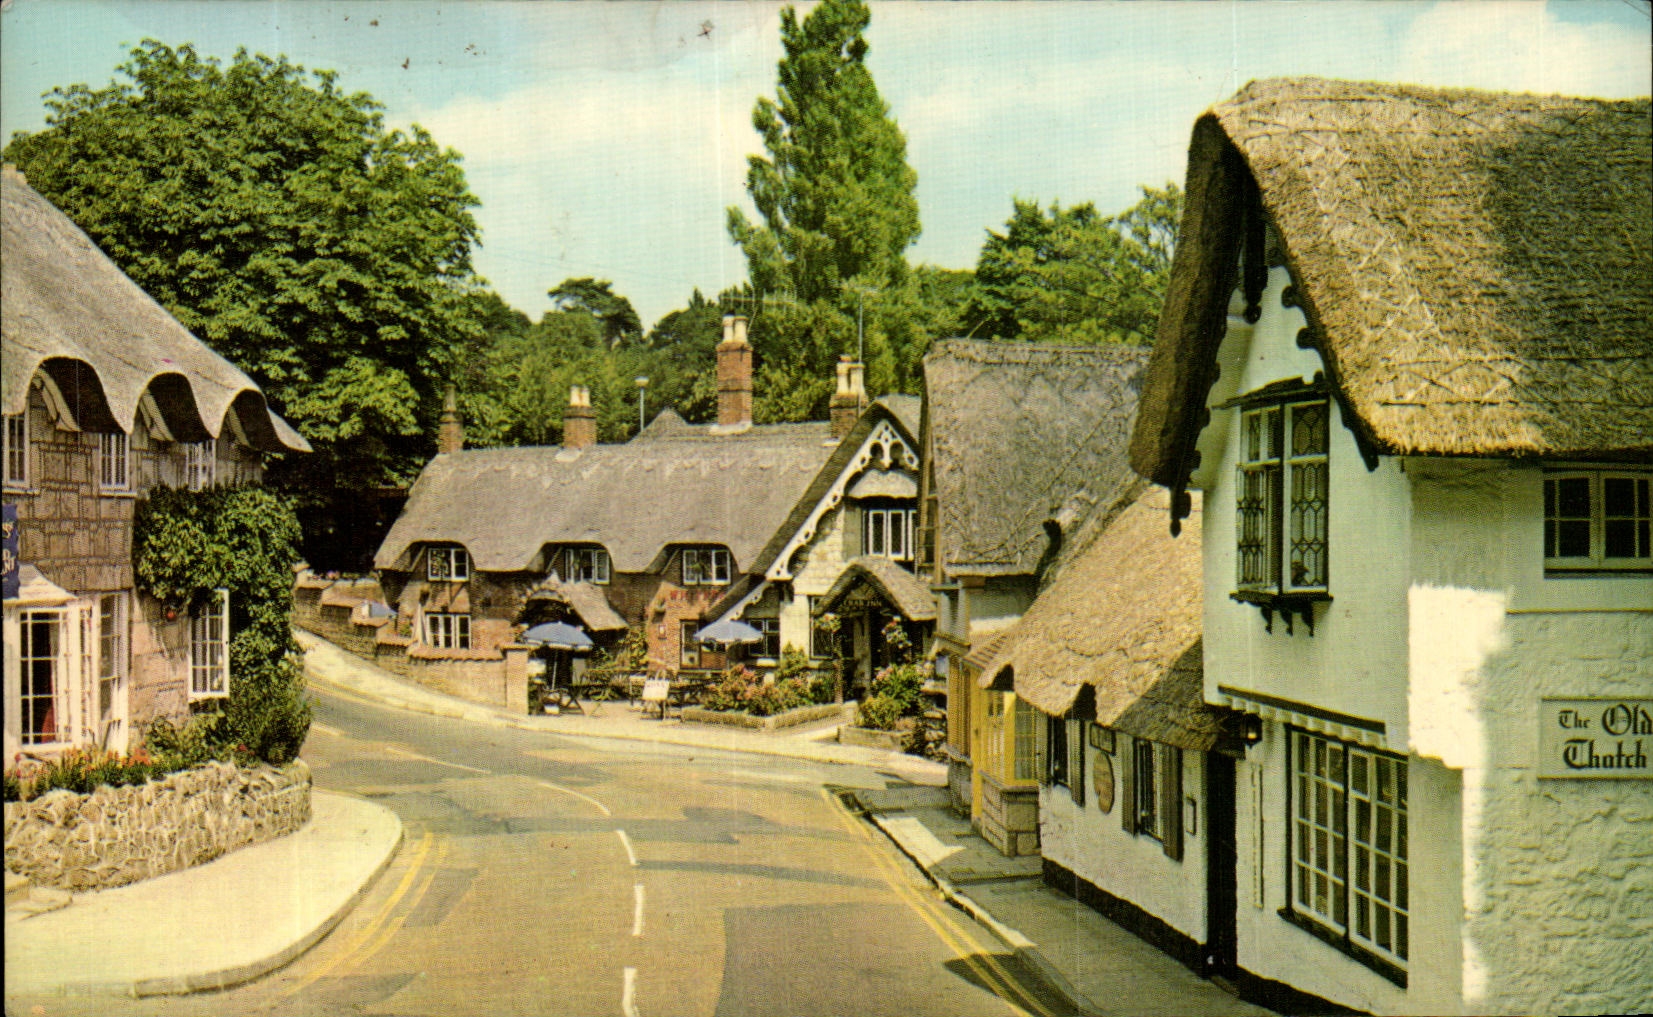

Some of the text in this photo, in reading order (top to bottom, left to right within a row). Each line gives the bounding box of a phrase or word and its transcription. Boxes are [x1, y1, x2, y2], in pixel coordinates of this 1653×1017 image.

[1558, 703, 1653, 736] The Old
[1562, 737, 1647, 770] Thatch
